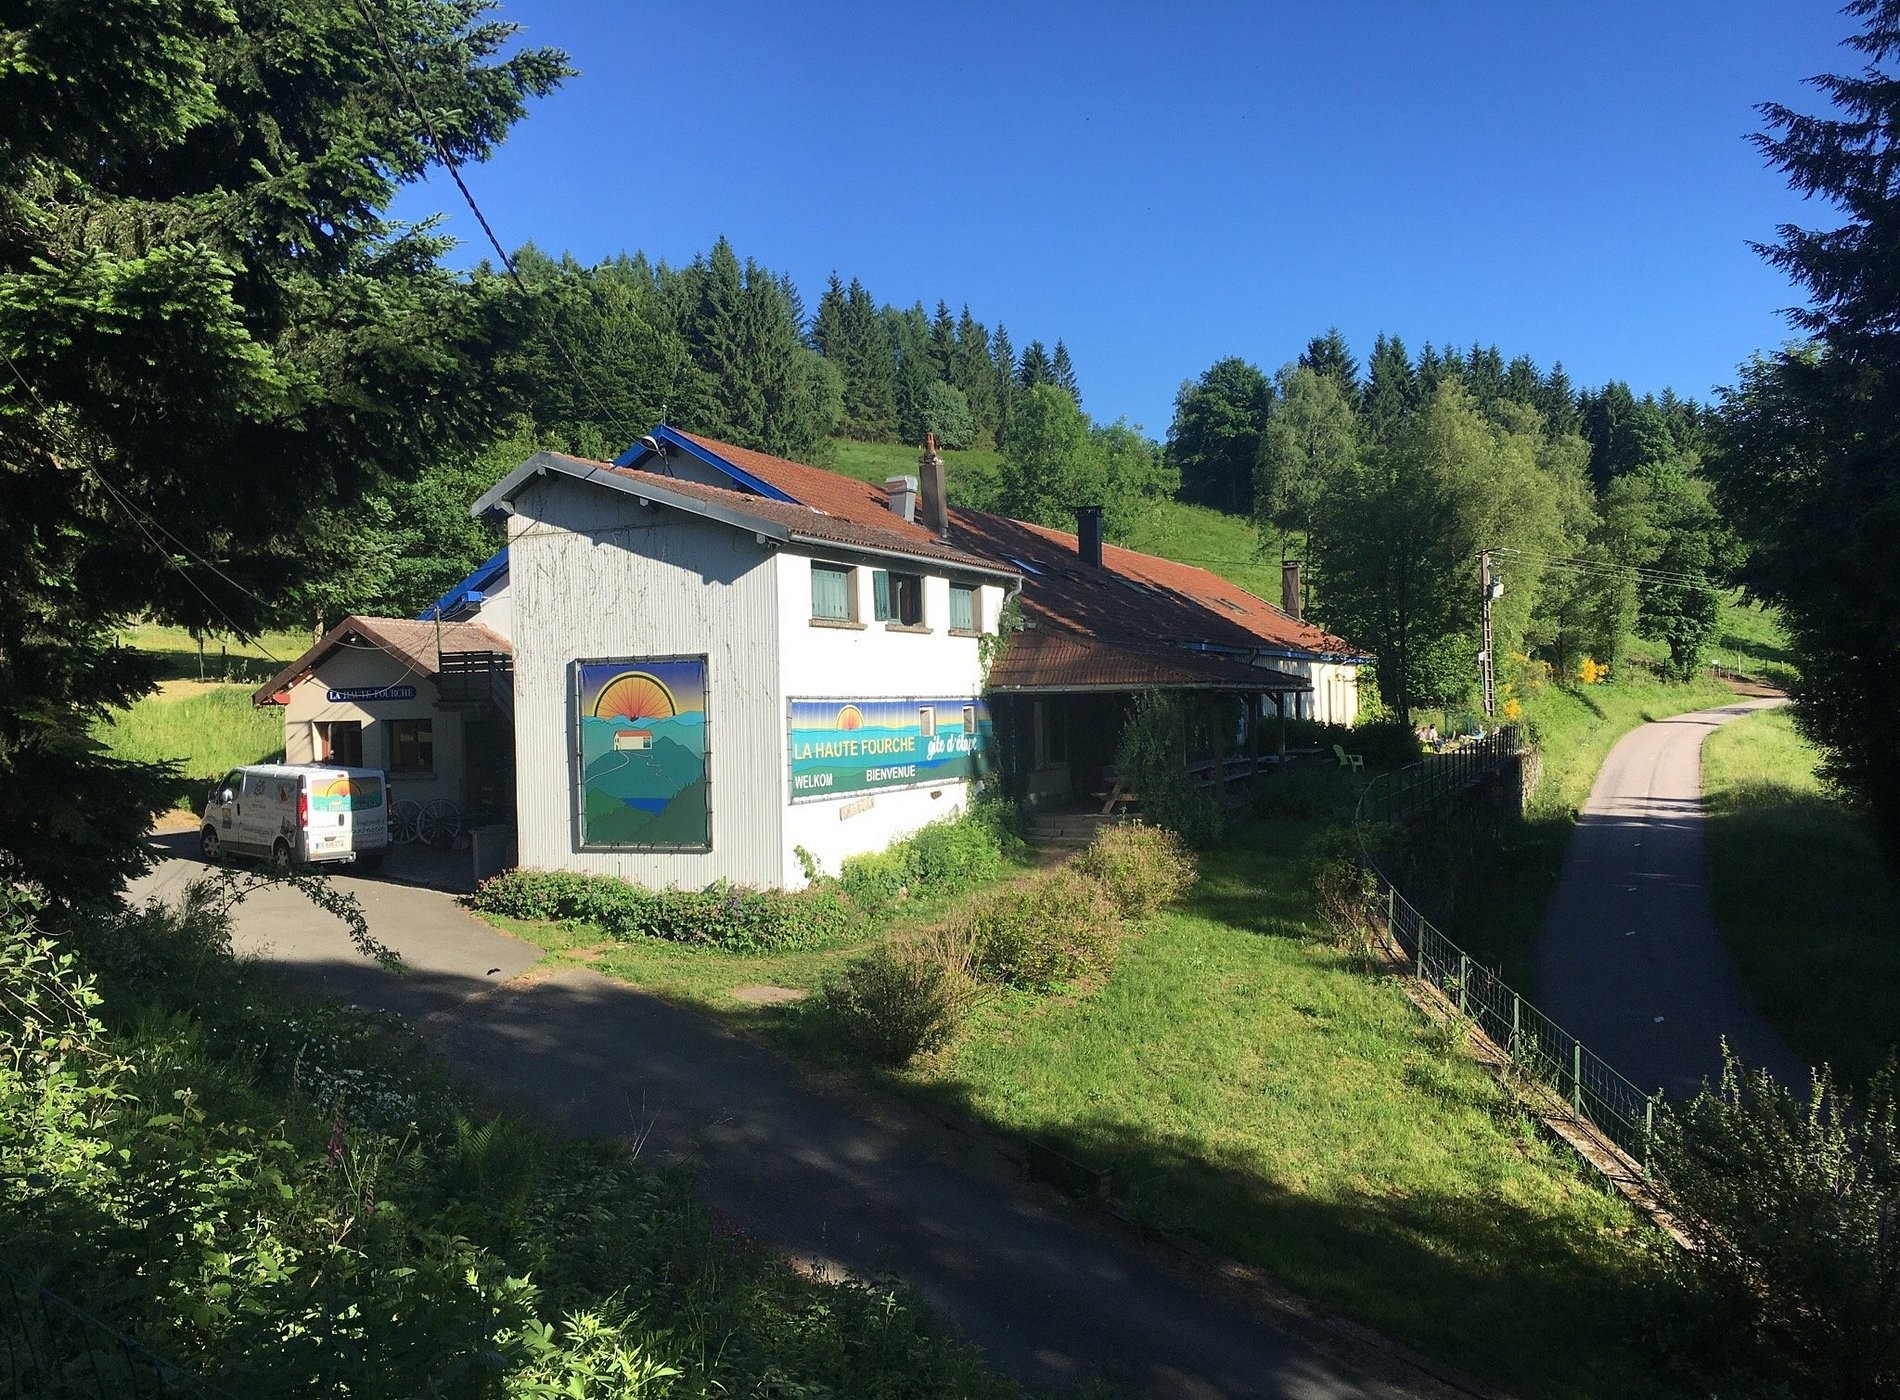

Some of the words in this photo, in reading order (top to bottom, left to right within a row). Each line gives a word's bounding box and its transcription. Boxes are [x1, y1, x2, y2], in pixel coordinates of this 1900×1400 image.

[329, 691, 341, 700] LA
[374, 688, 414, 699] FOURCHE
[794, 743, 813, 761] LA
[815, 741, 859, 759] HAUTE
[861, 737, 916, 756] FOURCHE
[794, 773, 833, 790] WELKOM
[866, 765, 916, 782] BIENVENUE
